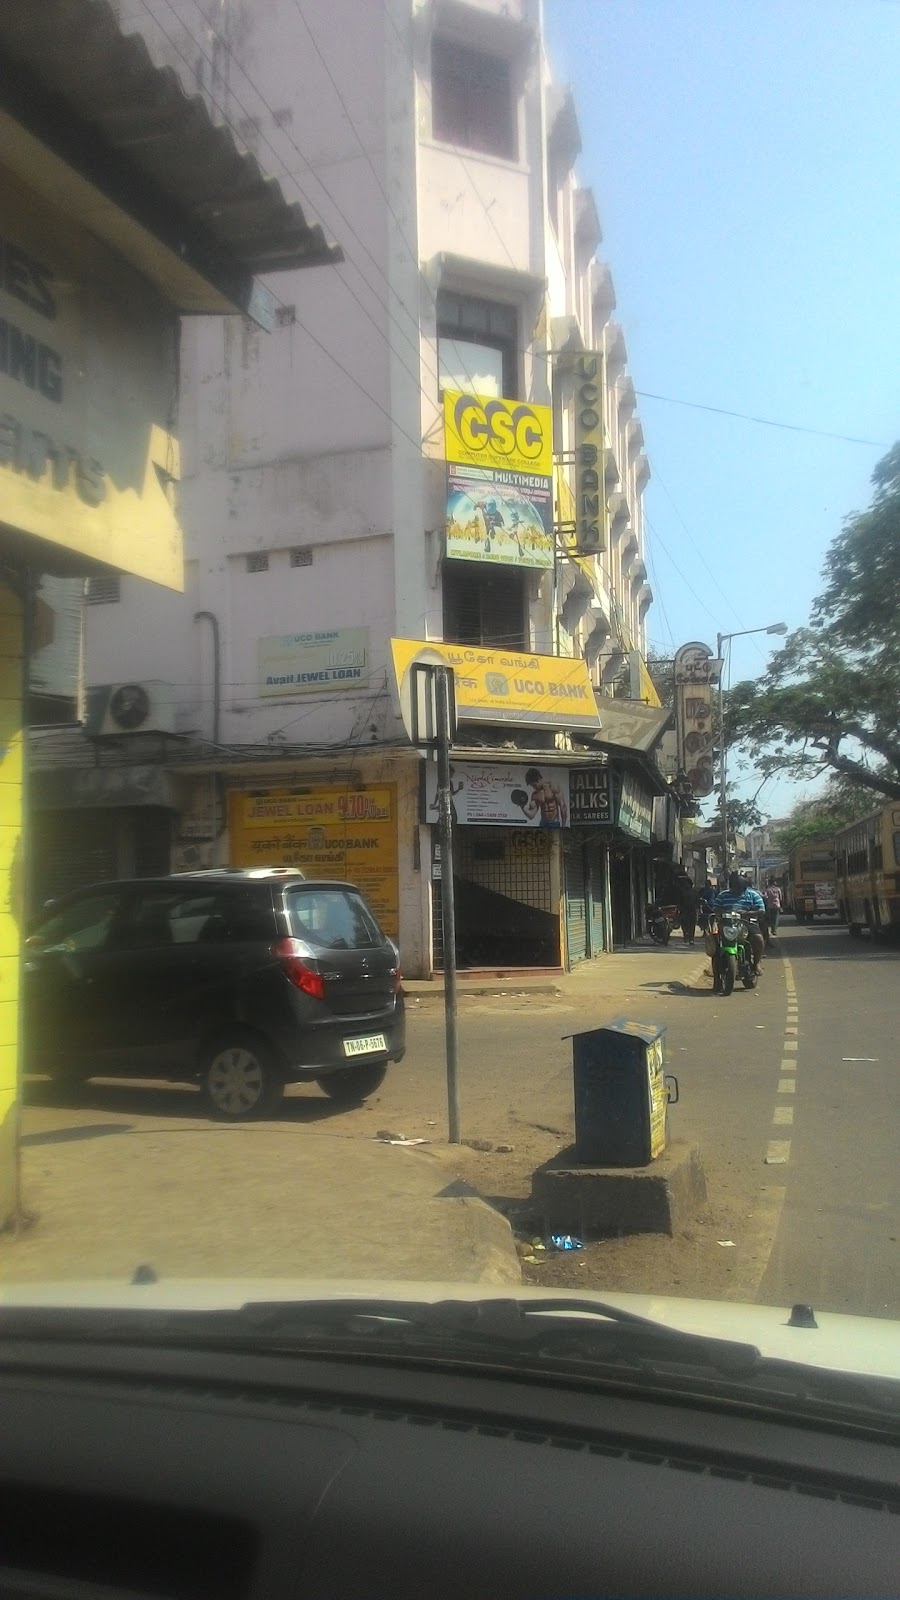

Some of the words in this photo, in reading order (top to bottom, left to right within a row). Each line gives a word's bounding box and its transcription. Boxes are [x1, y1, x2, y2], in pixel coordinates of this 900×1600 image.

[579, 357, 599, 428] UCO
[454, 394, 544, 460] CSC
[458, 449, 487, 459] COMPUTER
[494, 471, 549, 489] MULTIMEDIA
[578, 443, 600, 547] BANK
[294, 633, 313, 643] UCO
[315, 631, 340, 640] BANK
[266, 674, 294, 686] Avail
[296, 671, 330, 683] JEWEL
[332, 668, 361, 679] LOAN
[513, 678, 545, 696] UCO
[548, 682, 589, 700] BANK
[248, 806, 293, 818] JEWEL
[297, 802, 335, 815] LOAN
[583, 812, 609, 820] SAREES
[324, 839, 345, 849] UCO
[346, 838, 380, 849] BANK
